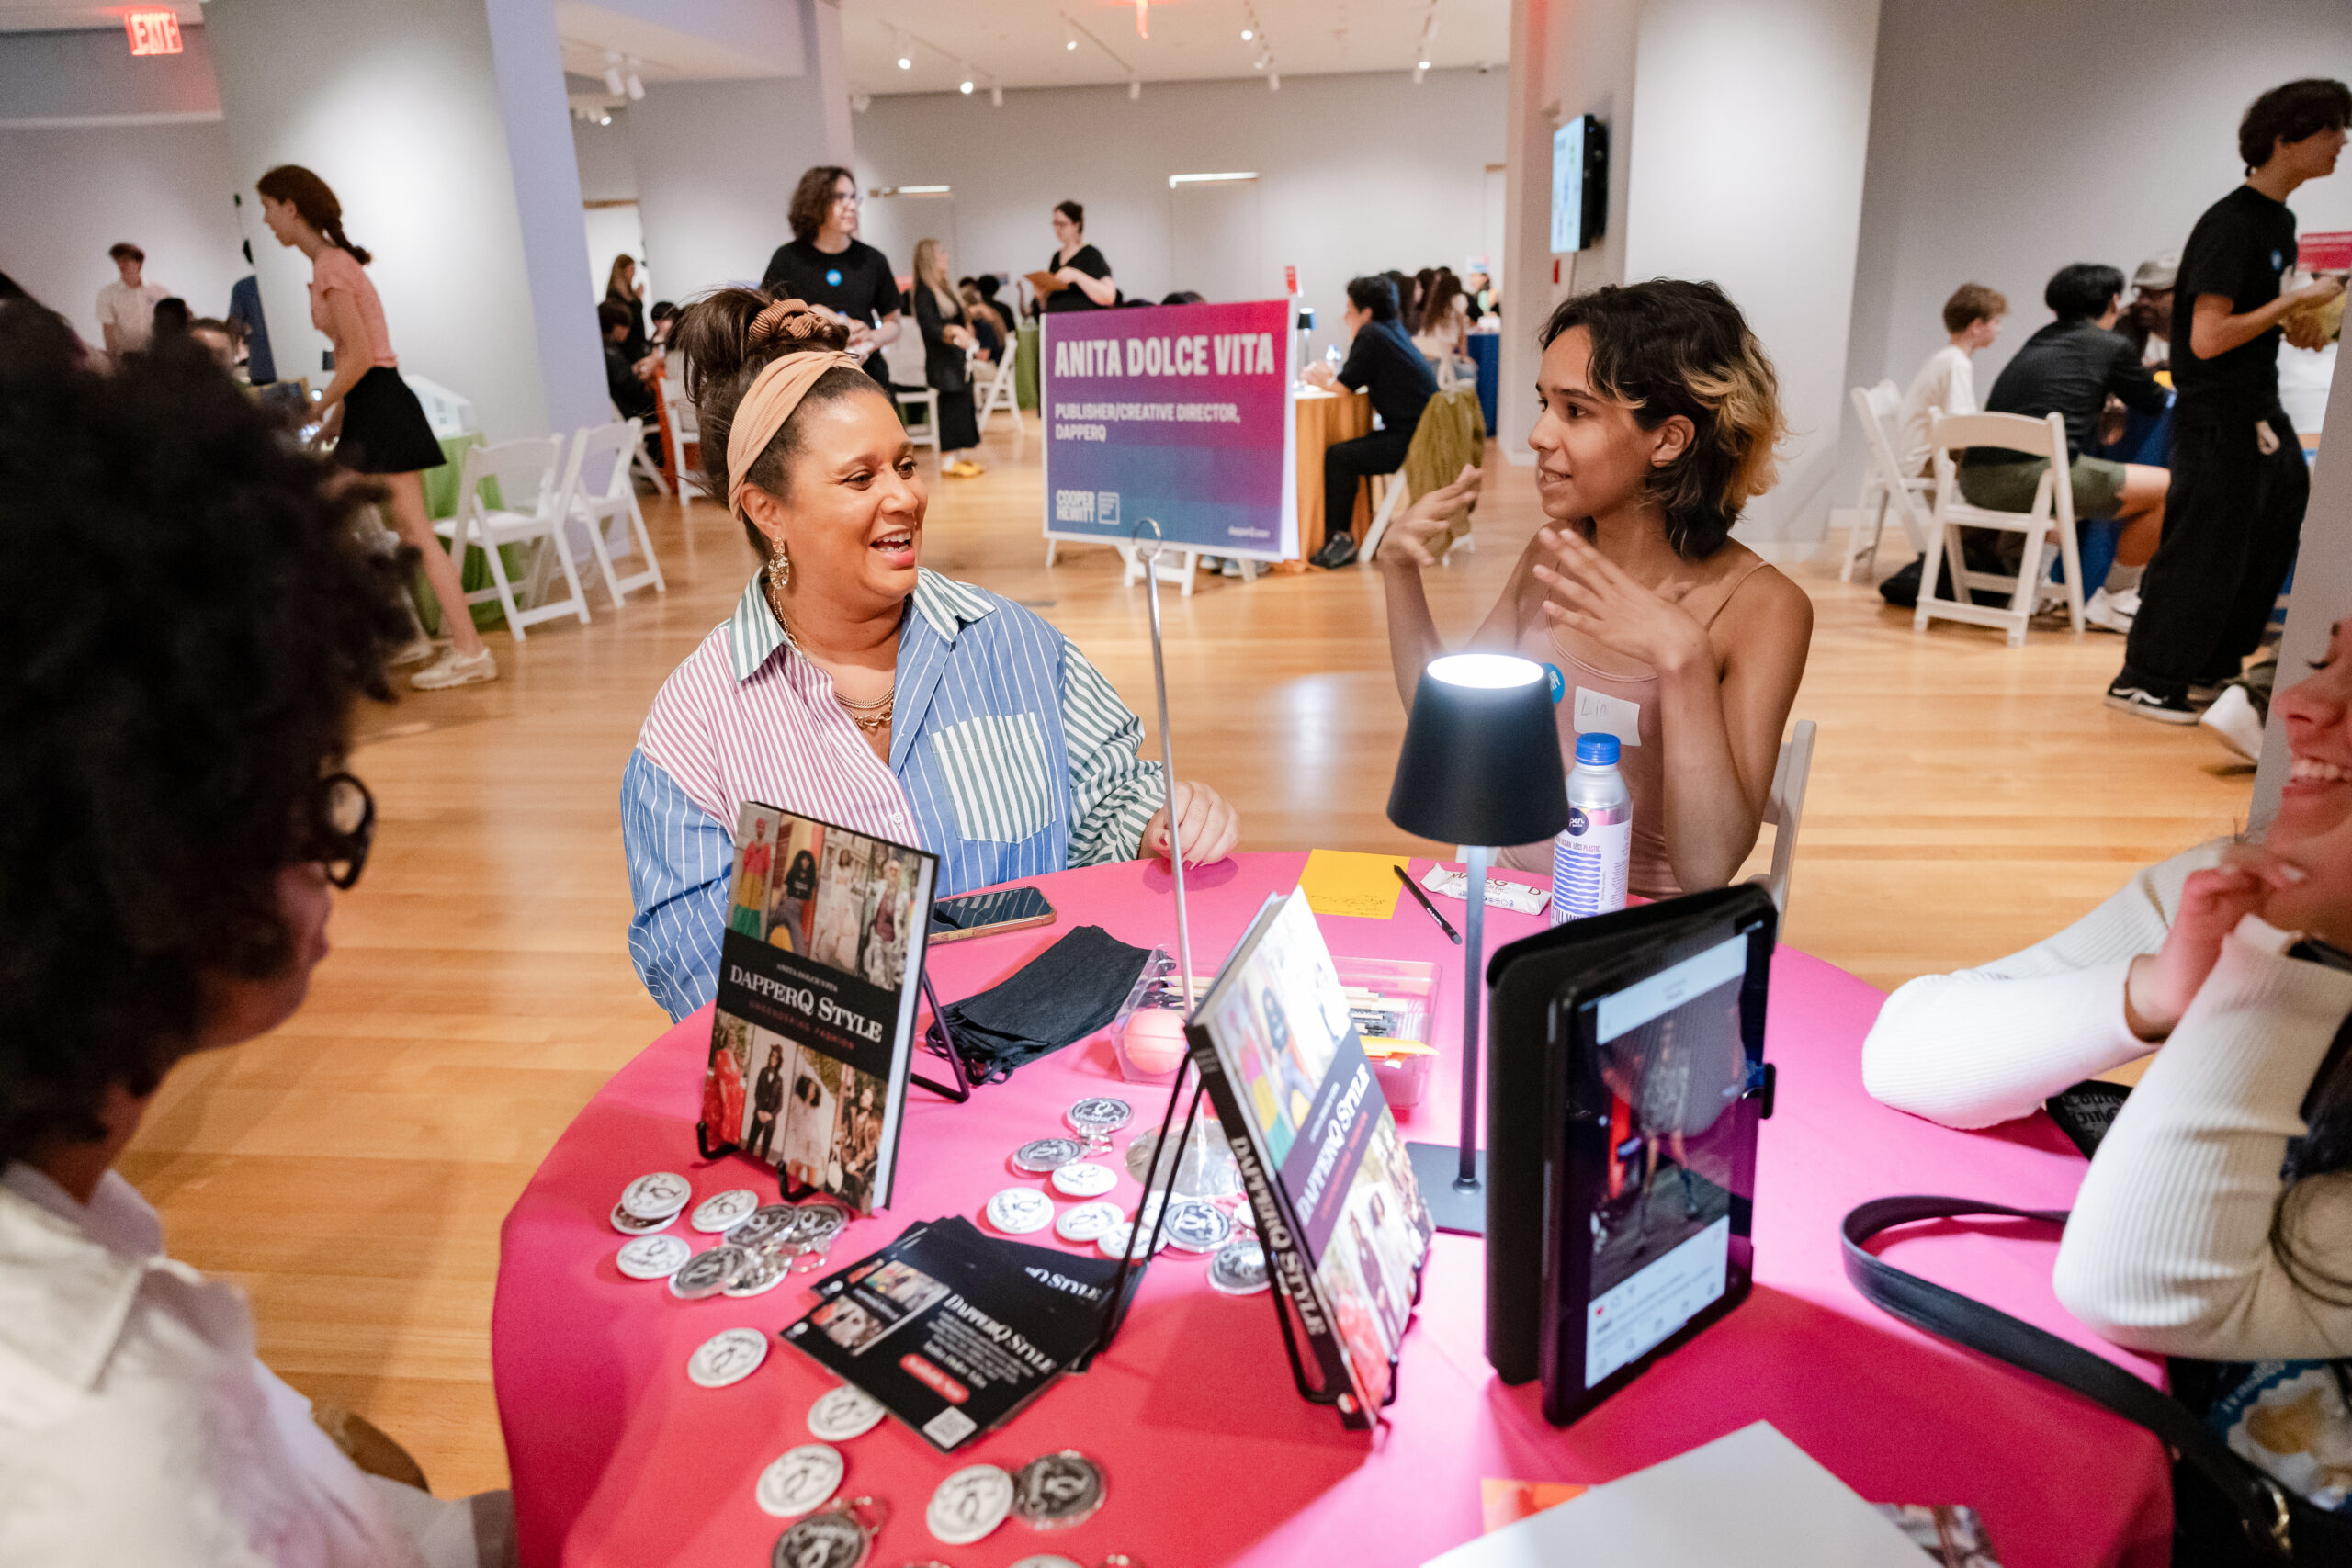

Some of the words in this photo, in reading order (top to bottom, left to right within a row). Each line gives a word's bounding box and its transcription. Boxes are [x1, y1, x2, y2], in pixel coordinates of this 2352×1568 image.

[130, 12, 179, 55] EXIT
[1055, 339, 1123, 378] ANITA
[1126, 335, 1209, 377] DOLCE
[1214, 333, 1275, 375] VITA
[1055, 402, 1174, 422] PUBLISHER/CREATIVE
[1177, 403, 1241, 423] DIRECTOR,
[1055, 423, 1107, 443] DAPPERQ
[1057, 489, 1095, 506] COOPER
[1057, 505, 1095, 523] HEWITT
[729, 964, 815, 1017] DAPPERQ
[817, 996, 884, 1043] STYLE
[1229, 1135, 1293, 1252] DAPPERQ
[1278, 1249, 1327, 1337] STYLE
